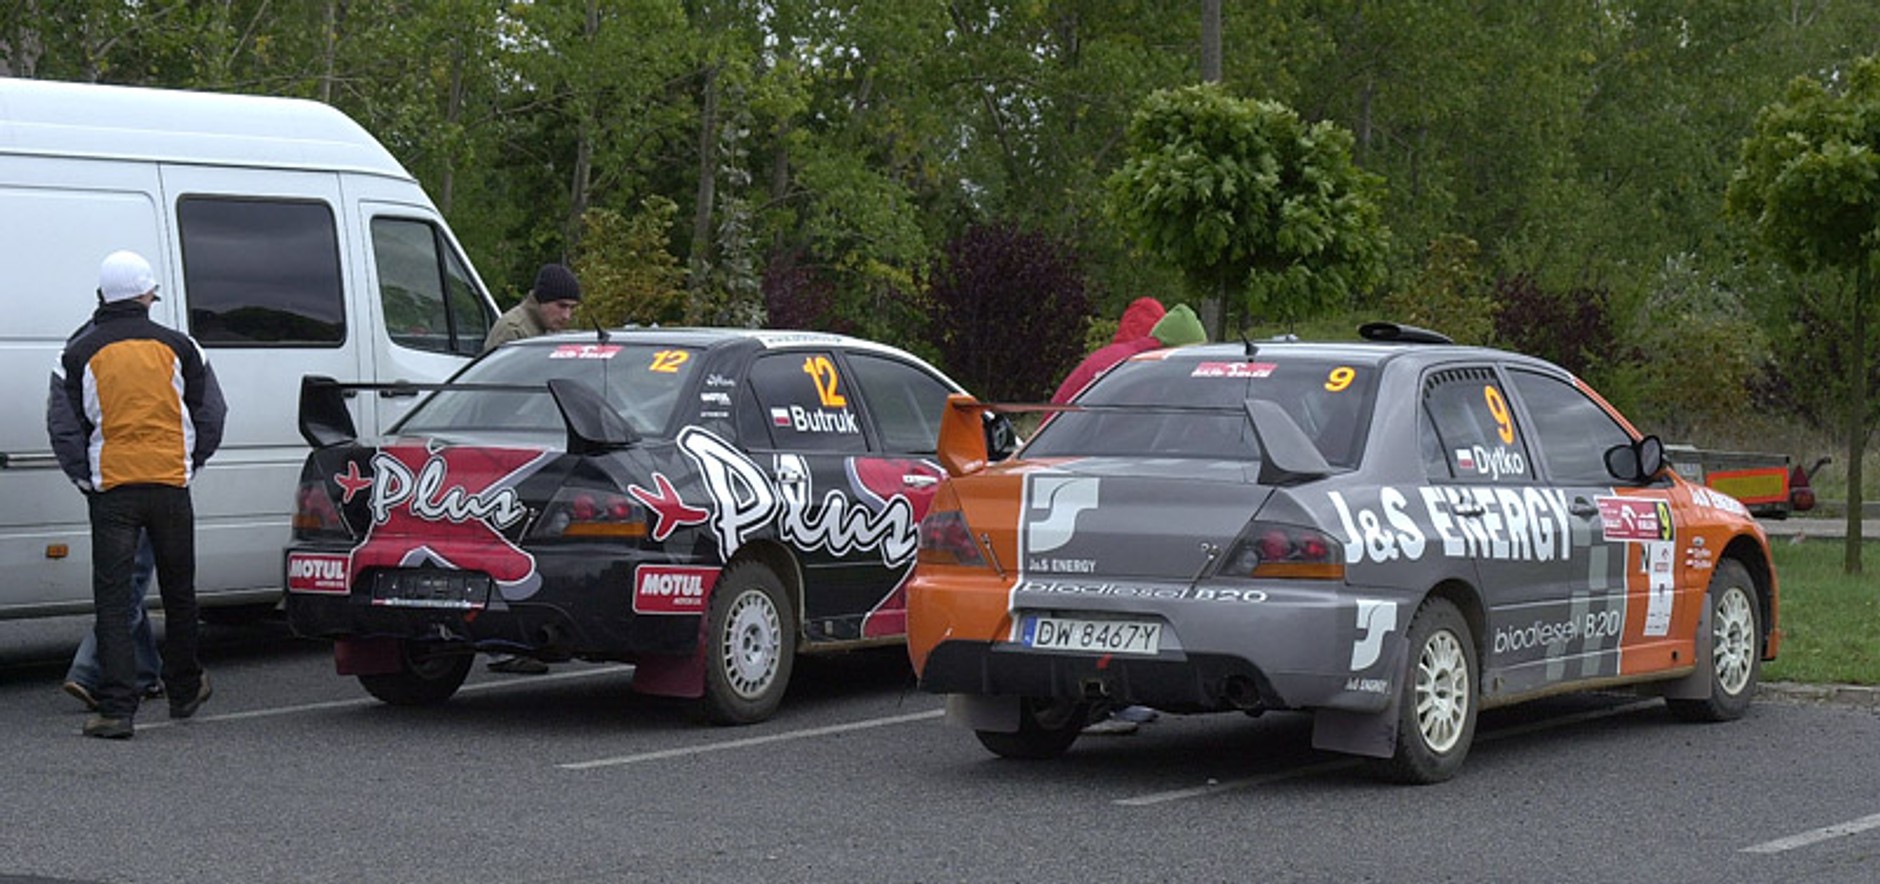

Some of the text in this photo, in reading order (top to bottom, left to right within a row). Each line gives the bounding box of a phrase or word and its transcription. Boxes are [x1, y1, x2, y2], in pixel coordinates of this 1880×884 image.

[649, 350, 689, 373] 12
[803, 356, 846, 407] 12
[1324, 366, 1356, 392] 9
[790, 405, 859, 434] Butruk
[1484, 385, 1514, 445] 9
[1473, 445, 1524, 480] Dytko
[370, 453, 527, 529] Plus
[677, 425, 918, 568] Plus
[1327, 486, 1571, 564] J&S ENERGY
[1657, 502, 1672, 541] 9
[291, 559, 345, 580] MOTUL
[1052, 559, 1096, 573] ENERGY
[640, 573, 704, 596] MOTUL
[1022, 582, 1268, 601] biodiesel B20
[1036, 620, 1157, 651] DW 8467Y
[1494, 609, 1621, 653] biodiesel B20
